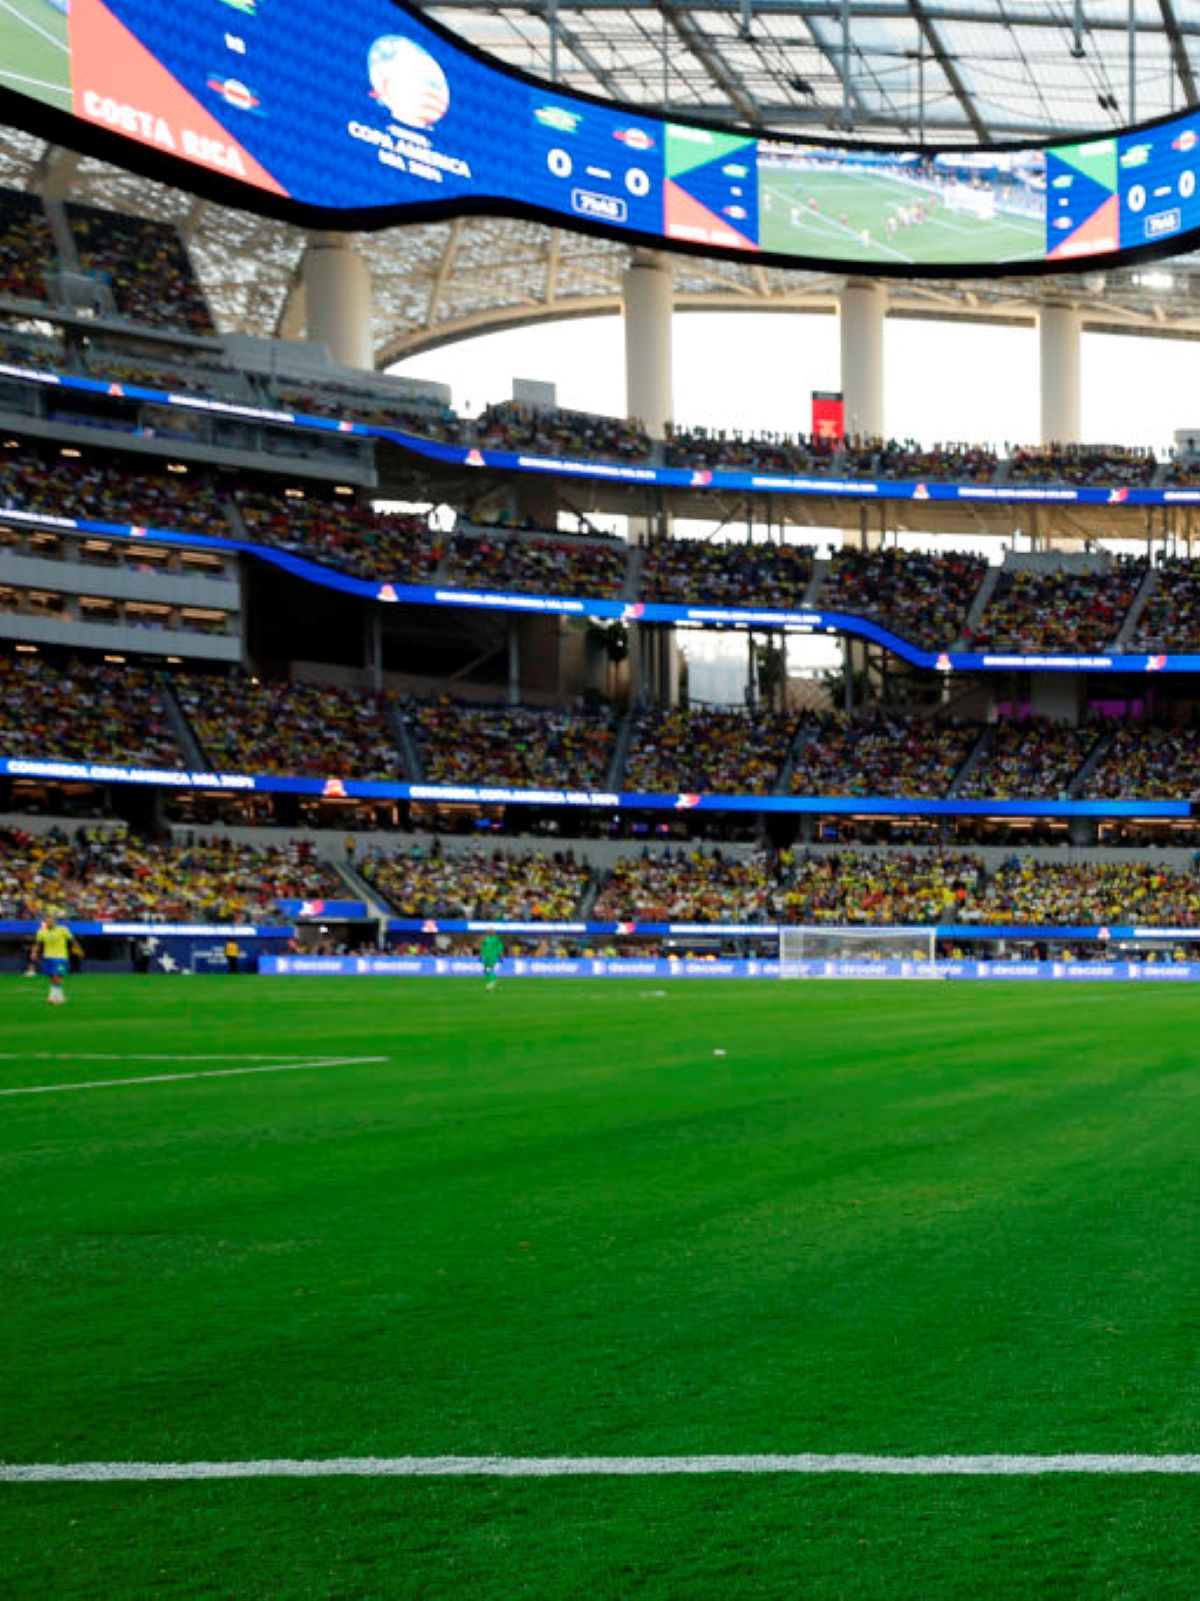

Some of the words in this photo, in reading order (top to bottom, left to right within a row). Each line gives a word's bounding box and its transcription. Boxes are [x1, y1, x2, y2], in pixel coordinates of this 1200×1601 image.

[83, 91, 176, 150] COSTA
[181, 130, 248, 176] RICA
[547, 149, 573, 178] 0
[625, 168, 650, 197] 0
[1128, 184, 1146, 212] 0
[1178, 169, 1196, 198] 0
